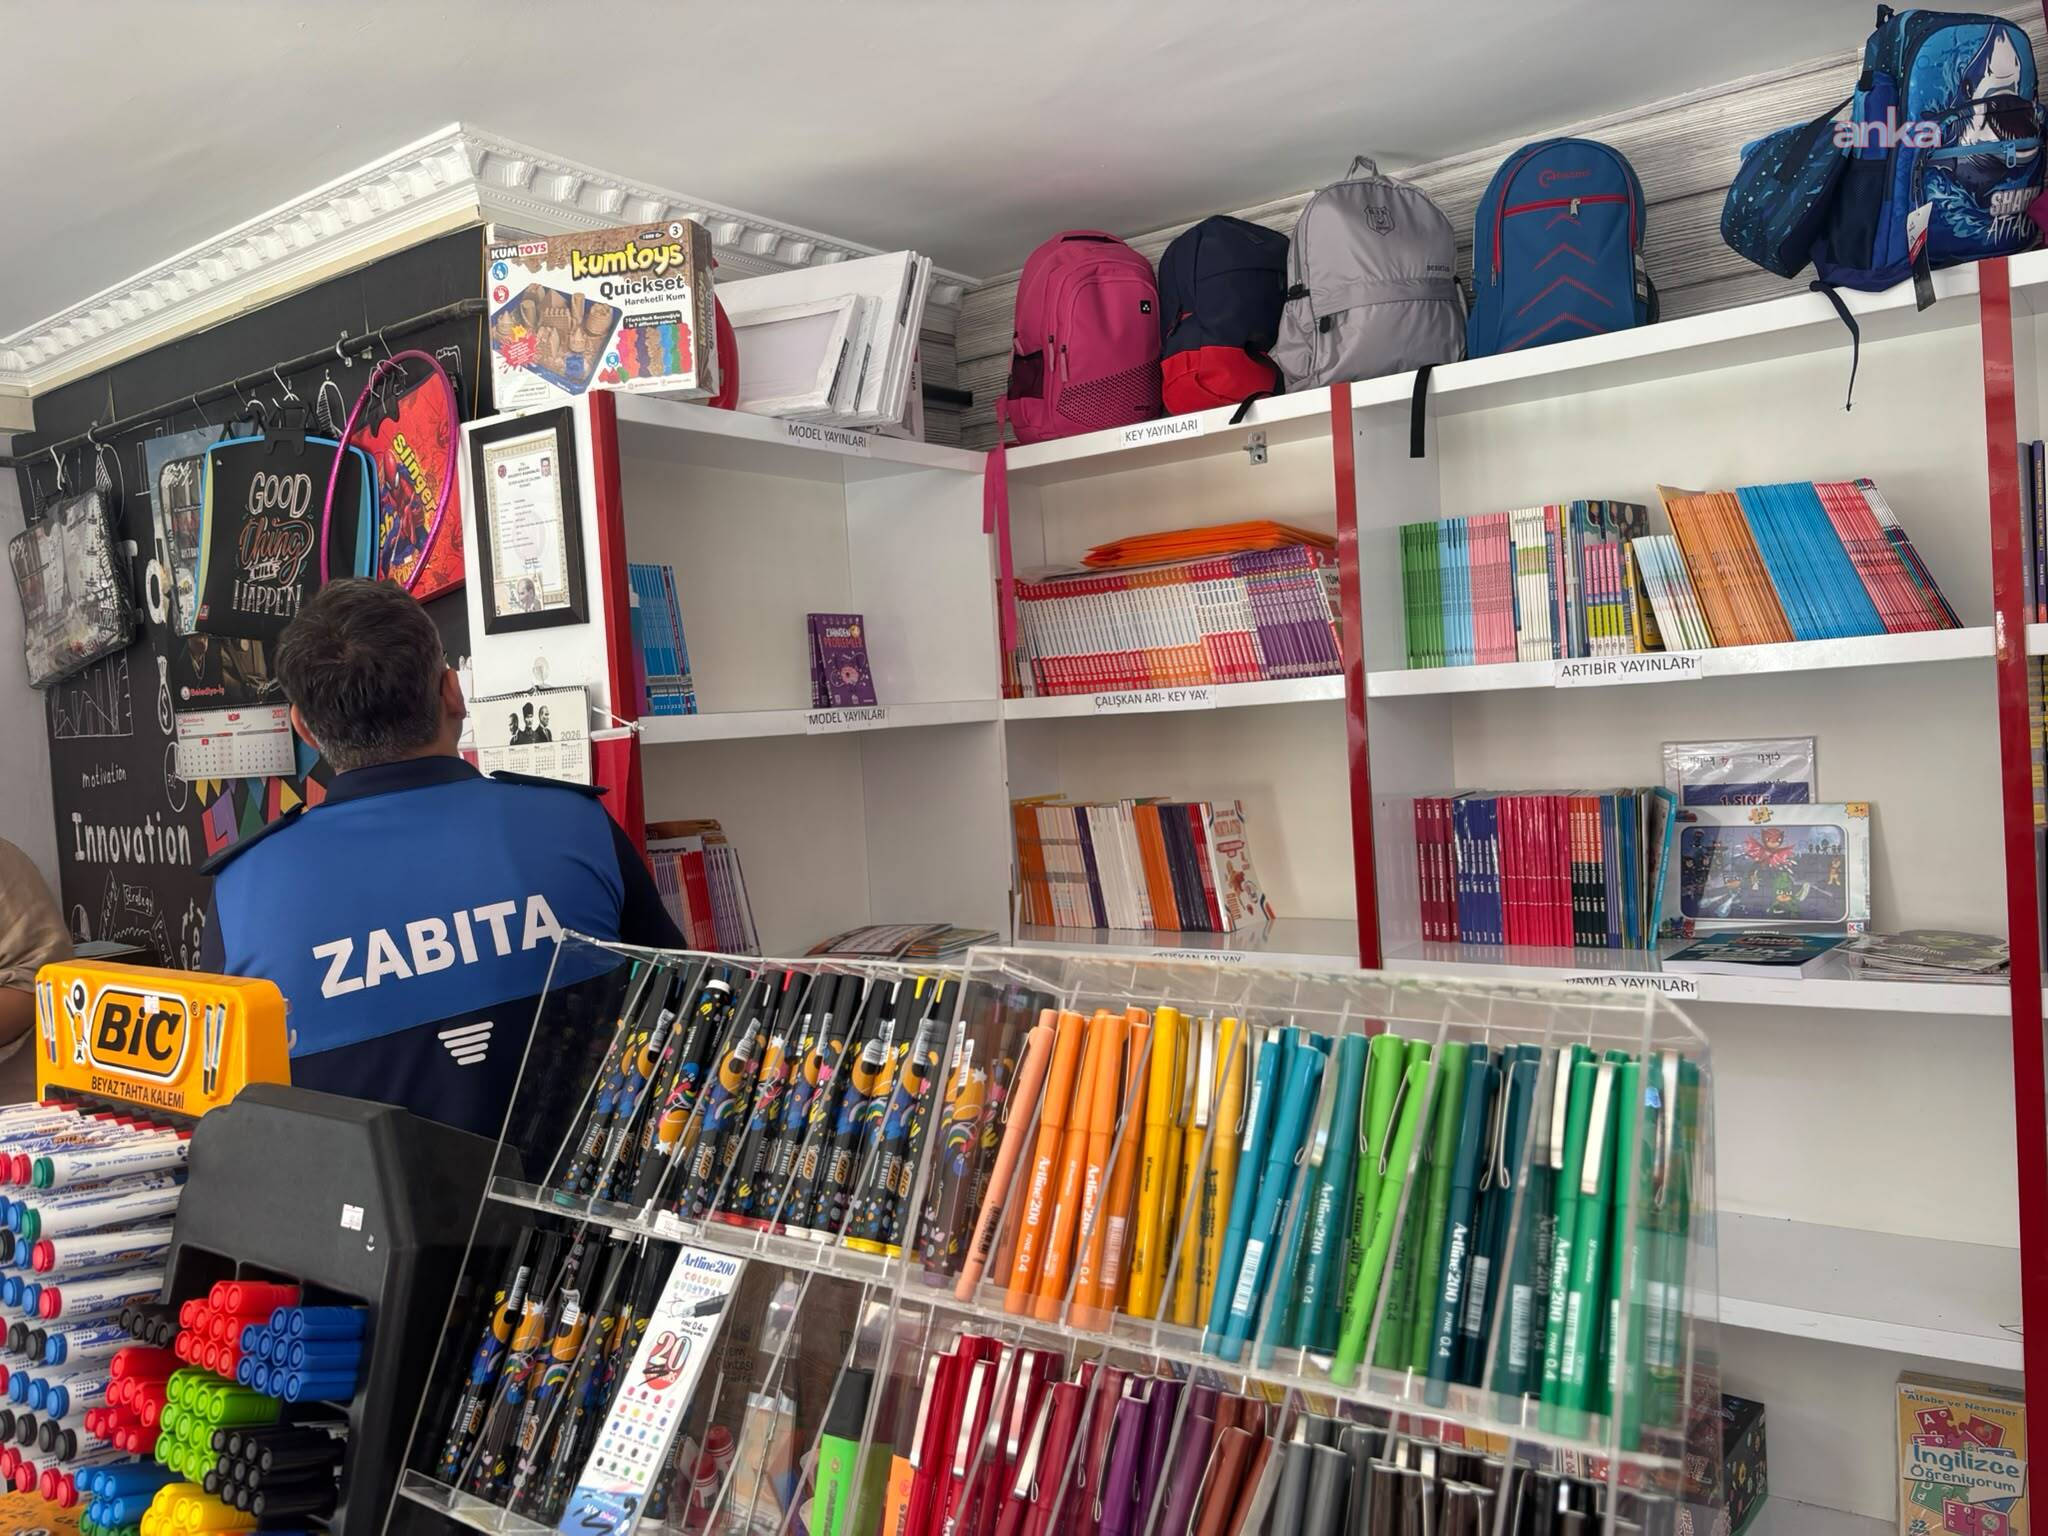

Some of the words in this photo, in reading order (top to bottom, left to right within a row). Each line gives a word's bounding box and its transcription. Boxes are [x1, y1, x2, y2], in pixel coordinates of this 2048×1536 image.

[491, 242, 547, 259] KUMTOYS
[571, 242, 685, 281] kumtoys
[600, 275, 684, 300] Quickset
[625, 296, 664, 307] Hareketli
[666, 293, 686, 303] Kum
[788, 423, 822, 441] MODEL
[824, 429, 867, 448] YAYINLARI
[1125, 430, 1144, 443] KEY
[1146, 420, 1199, 440] YAYINLARI
[249, 471, 312, 518] GOOD
[1561, 658, 1618, 678] ARTIBİR
[1621, 656, 1696, 675] YAYINLARI
[1095, 693, 1143, 708] ÇALIŞKAN
[1167, 692, 1186, 704] KEY
[809, 712, 842, 725] MODEL
[843, 709, 886, 722] YAYINLARI
[560, 730, 581, 741] 2026
[82, 762, 127, 788] motivation
[71, 810, 192, 866] Innovation
[312, 893, 567, 999] ZABITA
[91, 1076, 119, 1094] BEYAZ
[120, 1081, 149, 1102] TAHTA
[150, 1088, 185, 1110] KALEMİ
[684, 1271, 723, 1286] COLOUR
[656, 1330, 692, 1371] 20
[1906, 1392, 1945, 1405] Alfabe
[1965, 1402, 2017, 1417] Nesneler
[1913, 1439, 2021, 1478] İngilizce
[1910, 1464, 2016, 1494] Öğreniyorum
